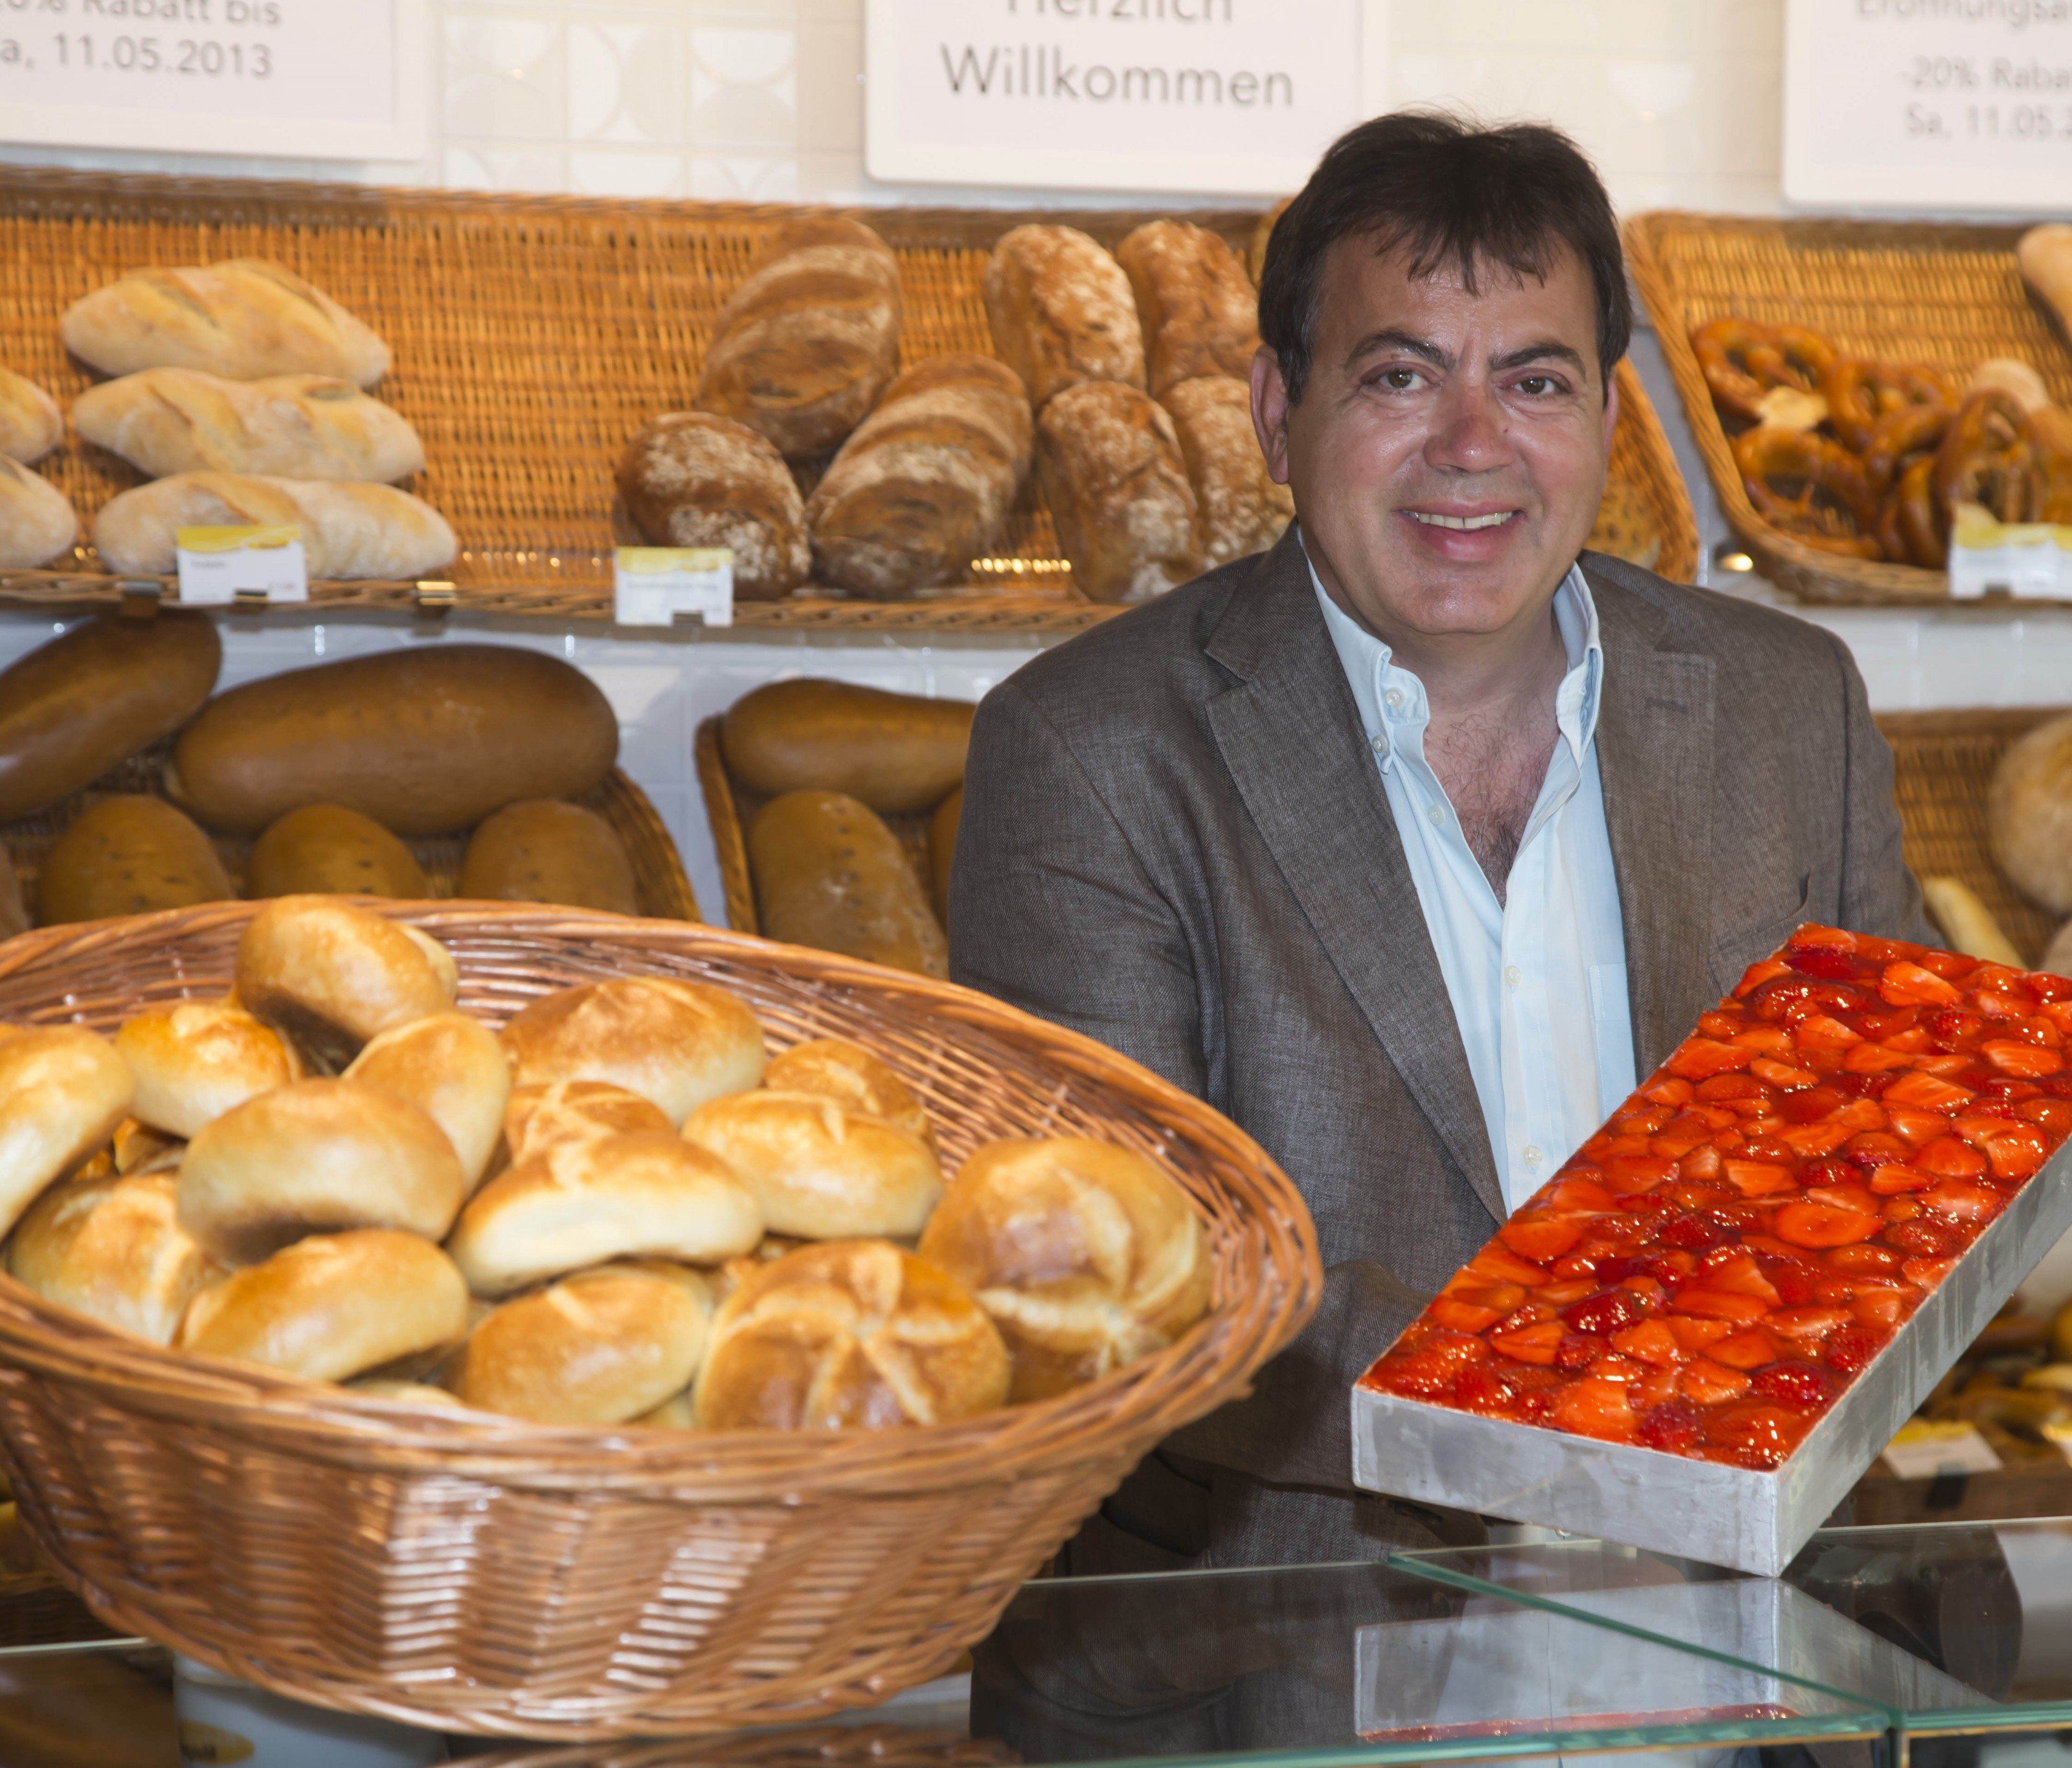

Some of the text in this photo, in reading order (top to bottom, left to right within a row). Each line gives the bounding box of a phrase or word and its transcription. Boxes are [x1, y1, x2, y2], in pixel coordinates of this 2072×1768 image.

[54, 33, 273, 78] 11.05.2013
[940, 43, 1294, 106] Willkommen
[1989, 56, 2072, 90] Raba
